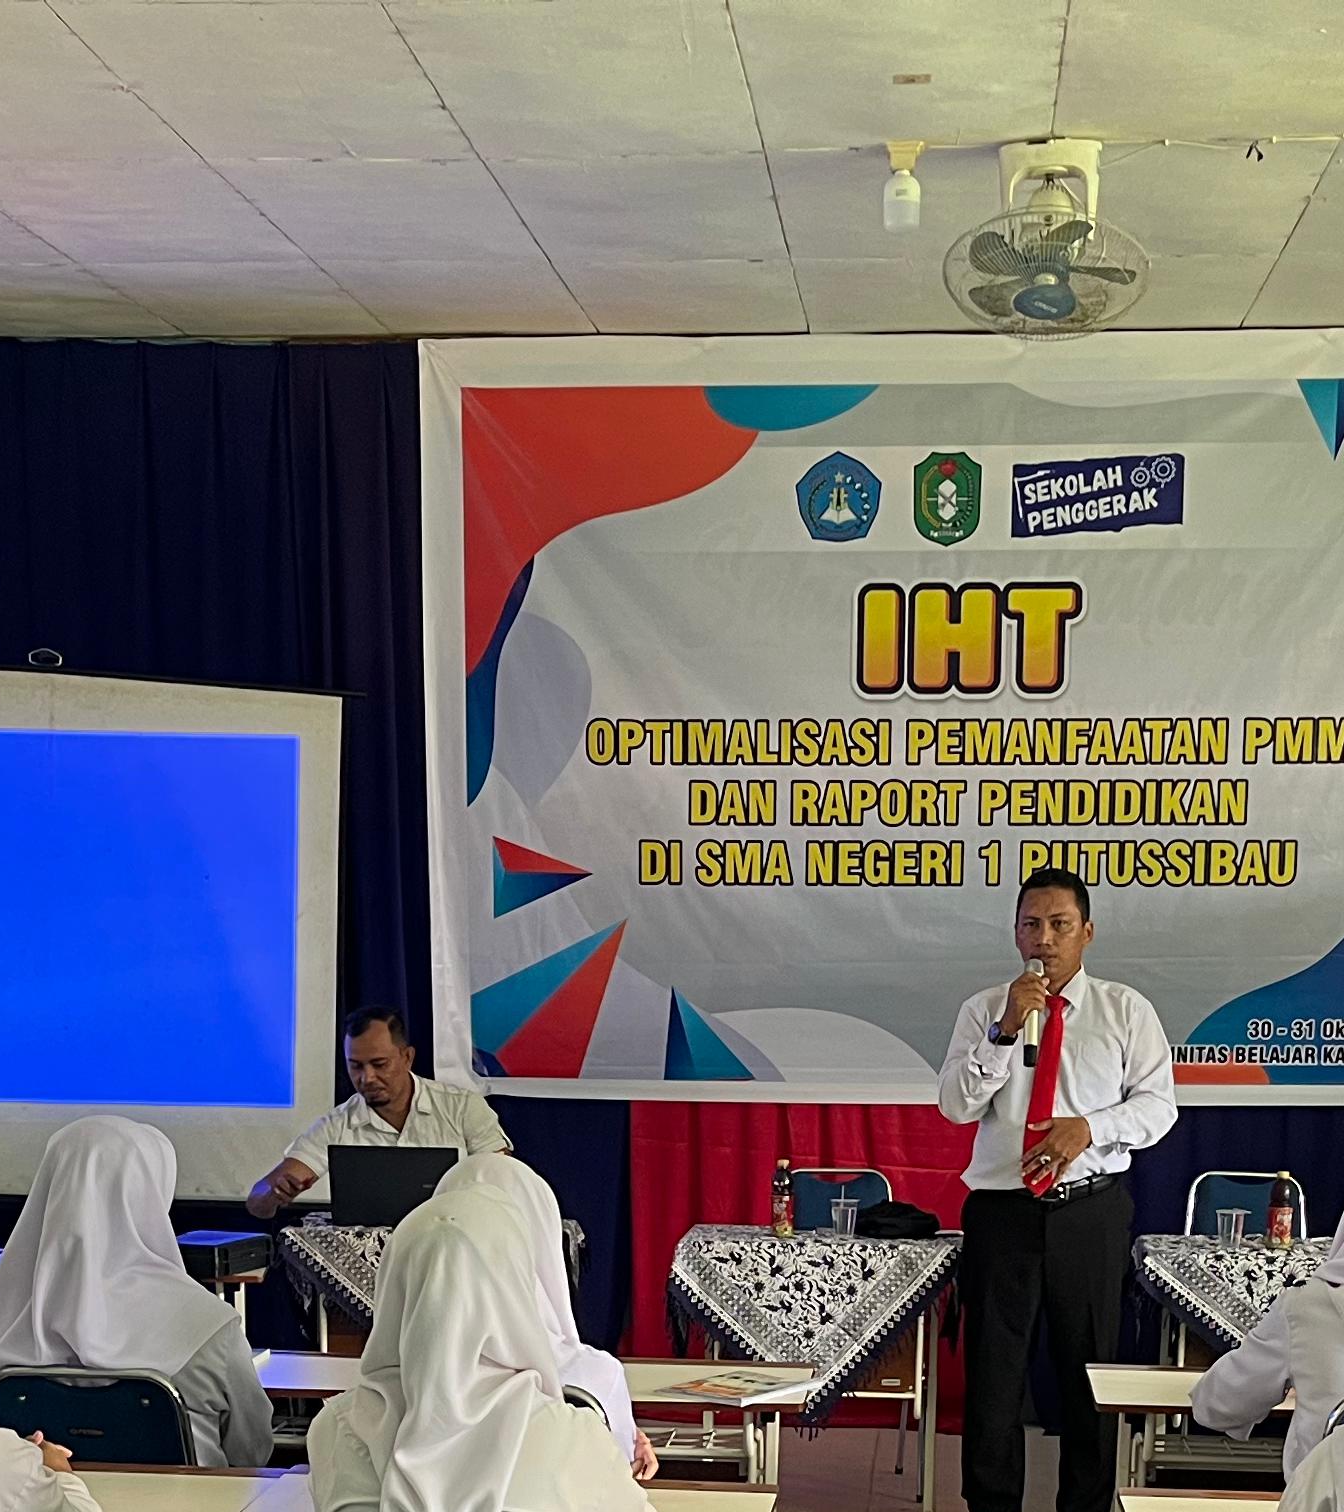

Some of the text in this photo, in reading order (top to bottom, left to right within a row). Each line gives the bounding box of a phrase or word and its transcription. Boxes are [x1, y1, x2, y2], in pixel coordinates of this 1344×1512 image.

[1023, 465, 1124, 505] SEKOLAH
[1027, 488, 1159, 532] PENGGERAK
[854, 580, 1084, 695] IHT
[586, 718, 891, 765] OPTIMALISASI
[905, 718, 1229, 765] PEMANFAATAN
[689, 779, 1249, 826] DAN RAPORT PENDIDIKAN
[639, 840, 683, 886] DI
[695, 840, 793, 886] SMA
[805, 840, 964, 886] NEGERI
[979, 840, 1001, 886] 1
[1247, 1019, 1272, 1040] 30
[1290, 1018, 1314, 1040] 31
[1233, 1044, 1316, 1066] BELAJAR
